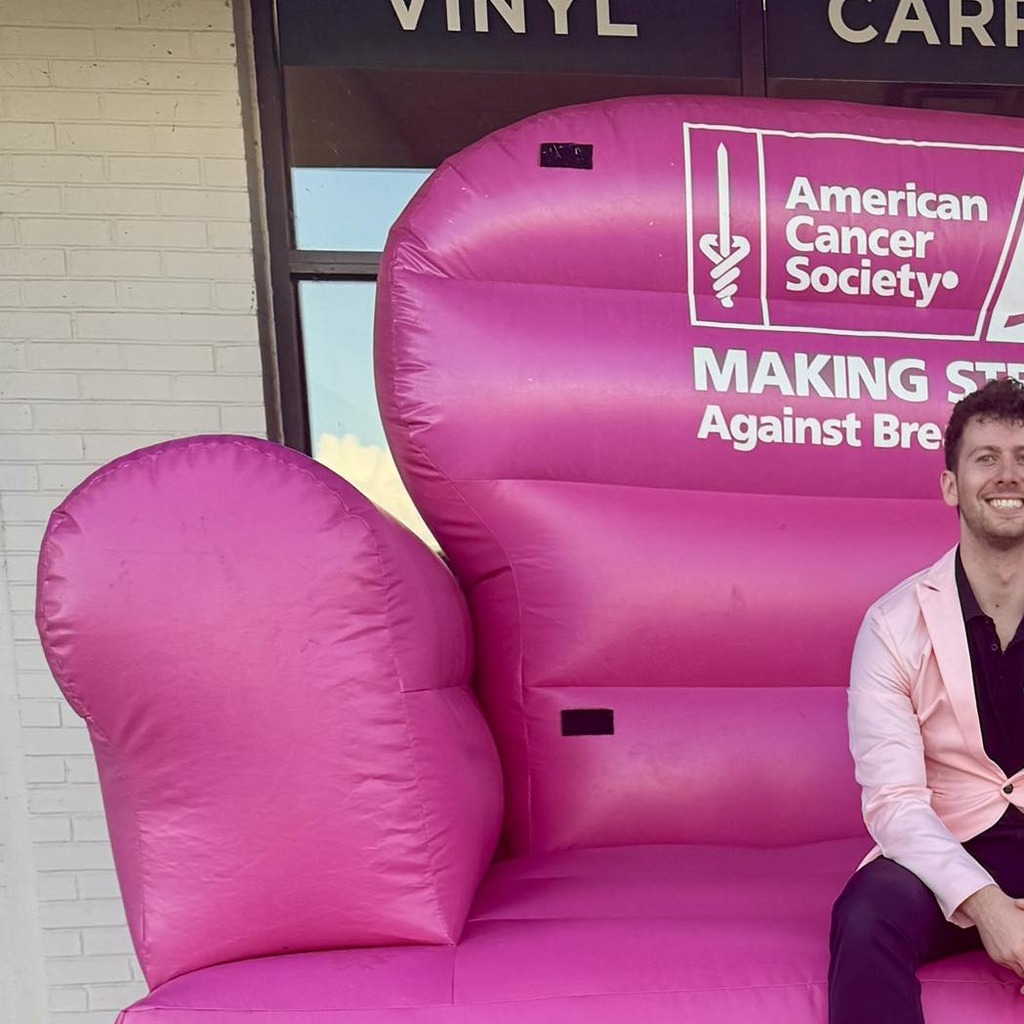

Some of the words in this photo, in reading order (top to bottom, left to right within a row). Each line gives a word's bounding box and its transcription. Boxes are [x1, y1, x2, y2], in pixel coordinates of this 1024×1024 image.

[391, 0, 638, 37] VINYL
[785, 176, 988, 222] American
[785, 215, 935, 259] Cancer
[693, 346, 929, 402] MAKING
[697, 404, 862, 452] Against
